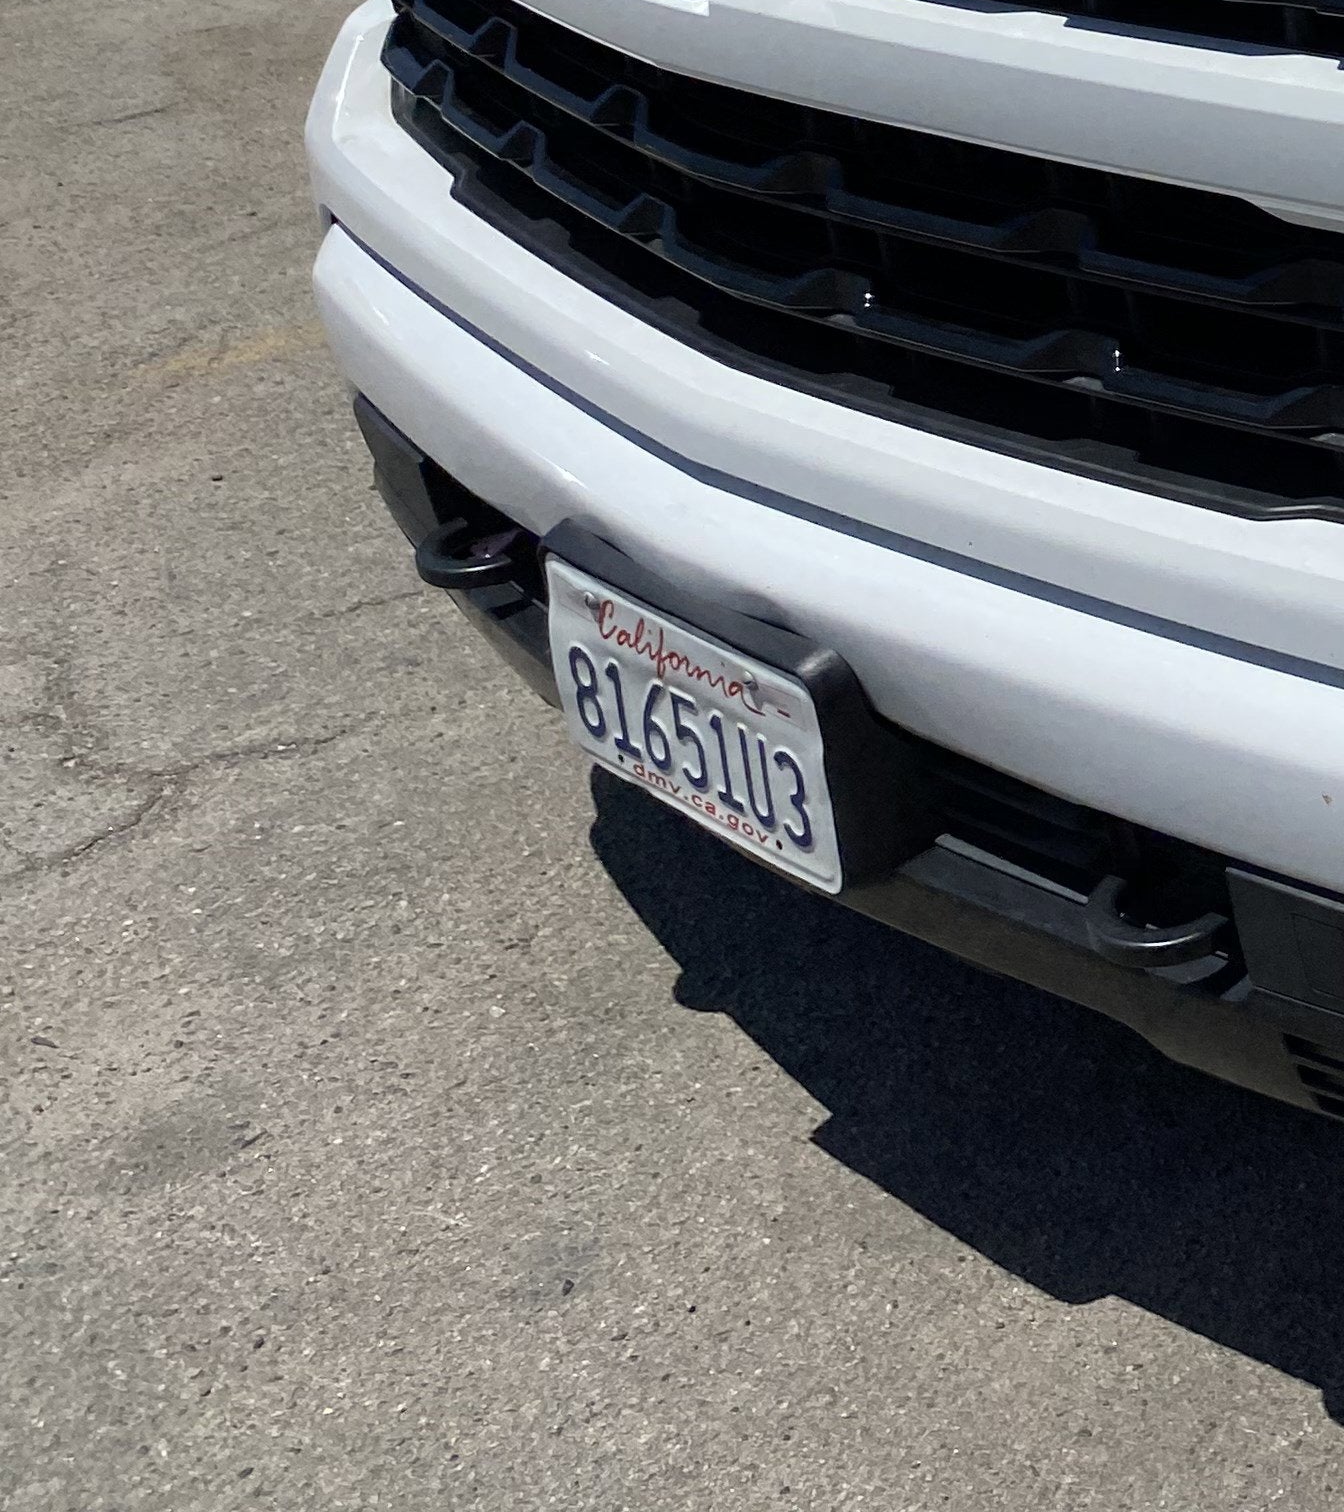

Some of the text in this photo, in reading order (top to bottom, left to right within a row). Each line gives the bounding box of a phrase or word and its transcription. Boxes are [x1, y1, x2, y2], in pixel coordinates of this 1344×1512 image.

[597, 599, 766, 716] California
[568, 645, 814, 849] 81651U3
[632, 762, 769, 843] dmv.ca.gov
